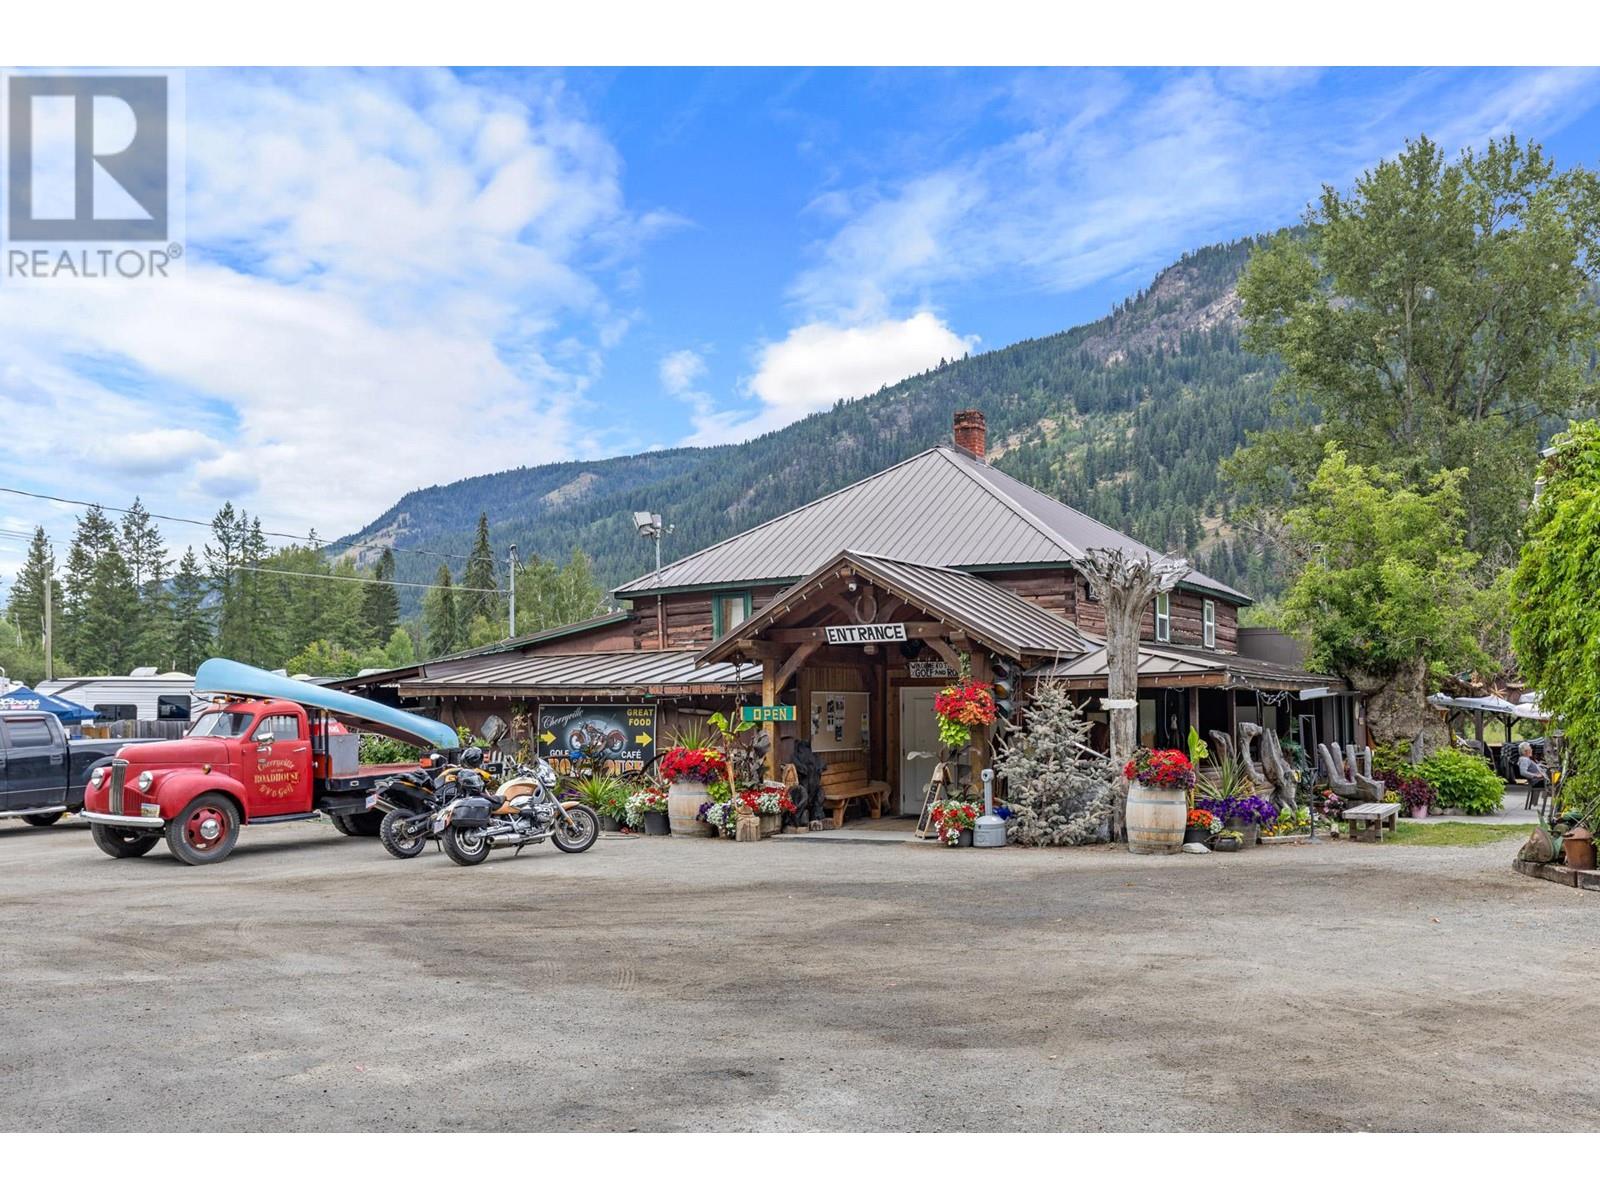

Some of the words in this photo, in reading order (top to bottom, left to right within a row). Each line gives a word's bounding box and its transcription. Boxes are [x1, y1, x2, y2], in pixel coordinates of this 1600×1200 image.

[827, 625, 904, 642] ENTRANCE
[915, 669, 932, 678] GOLF
[626, 708, 654, 717] GREAT
[753, 708, 787, 720] OPEN
[628, 718, 652, 727] FOOD
[549, 749, 570, 758] GOLF
[621, 749, 642, 759] CAFÉ
